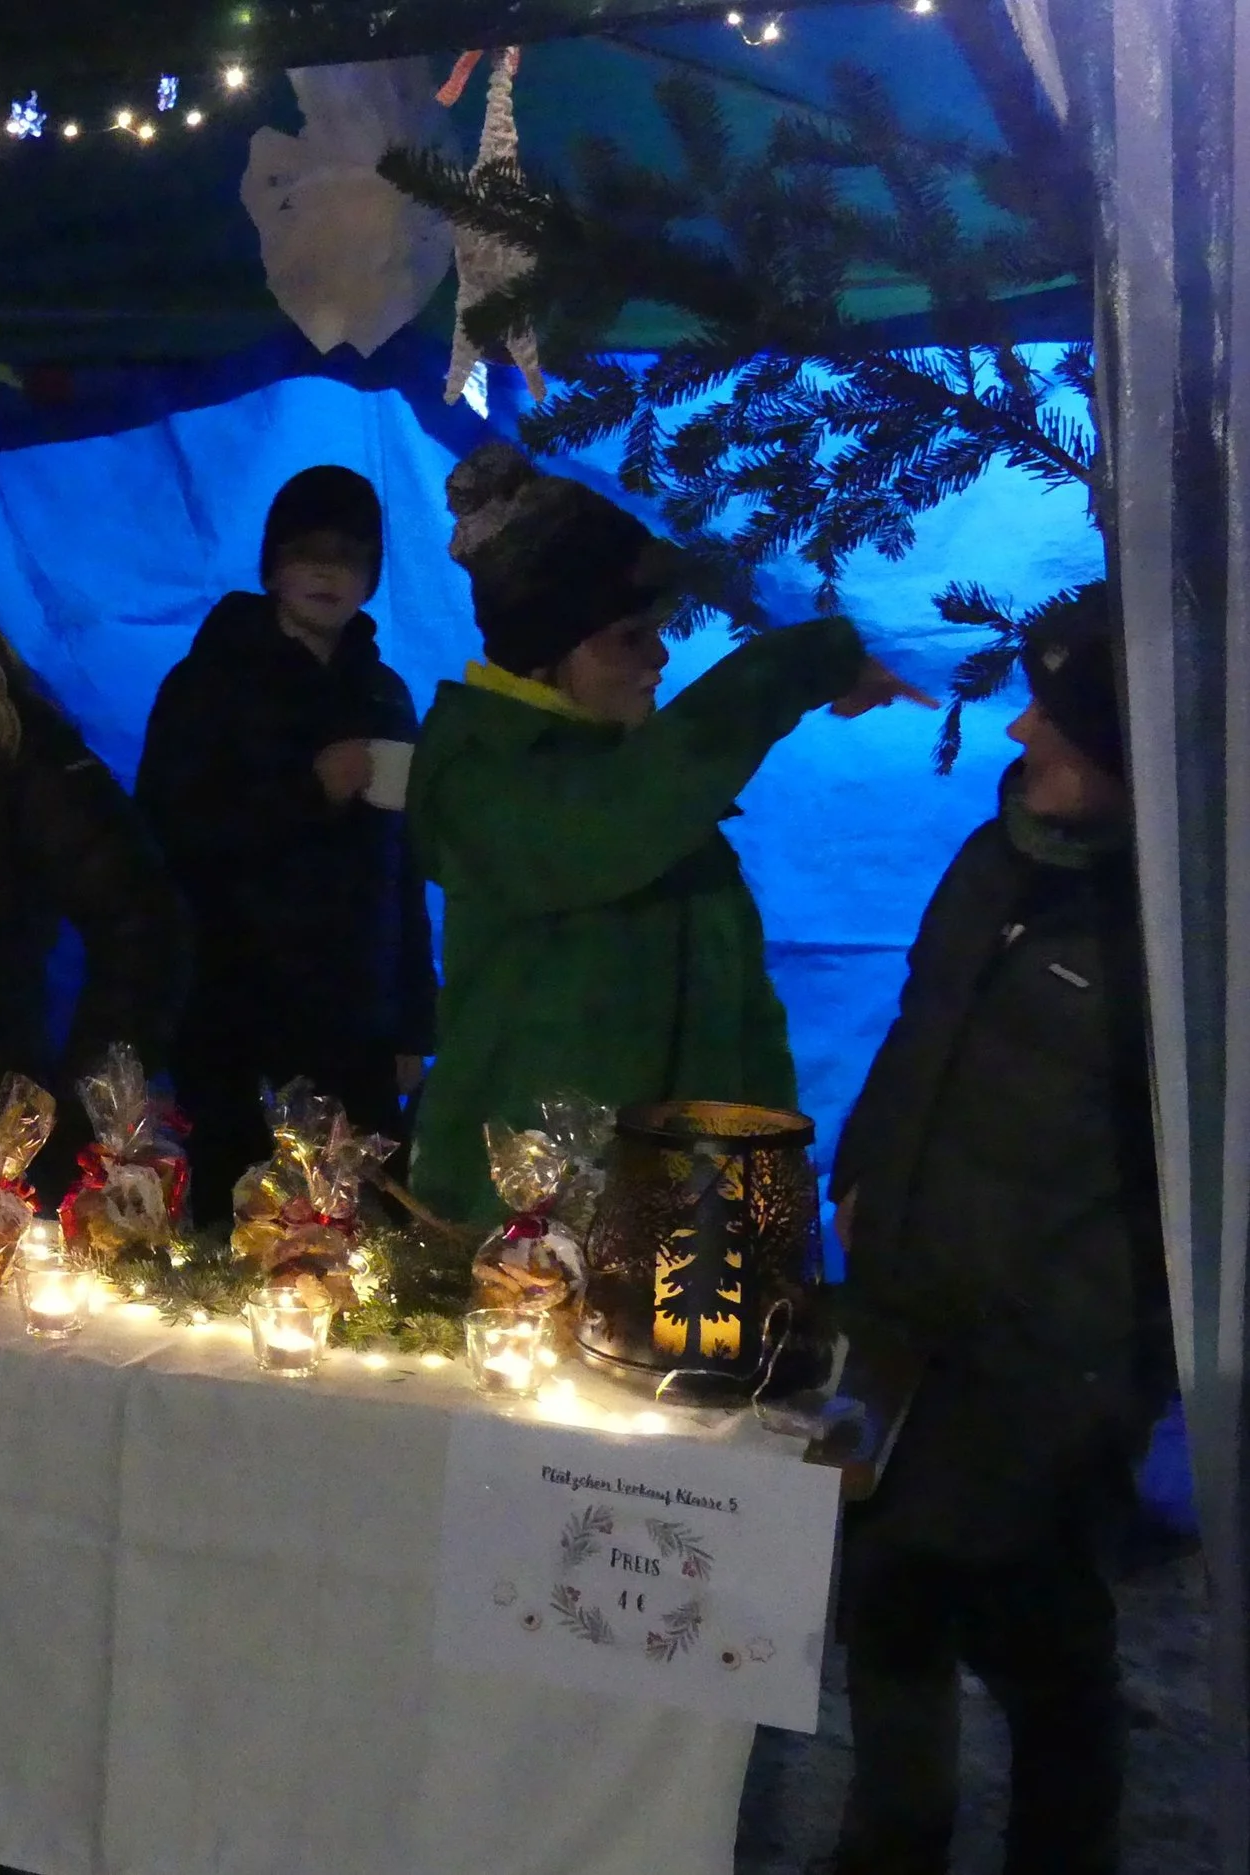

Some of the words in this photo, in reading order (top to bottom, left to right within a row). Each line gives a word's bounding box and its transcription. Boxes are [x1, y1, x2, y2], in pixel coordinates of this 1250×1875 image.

[675, 1487, 723, 1512] Klasse
[728, 1497, 739, 1512] 5
[611, 1547, 660, 1576] PREIS
